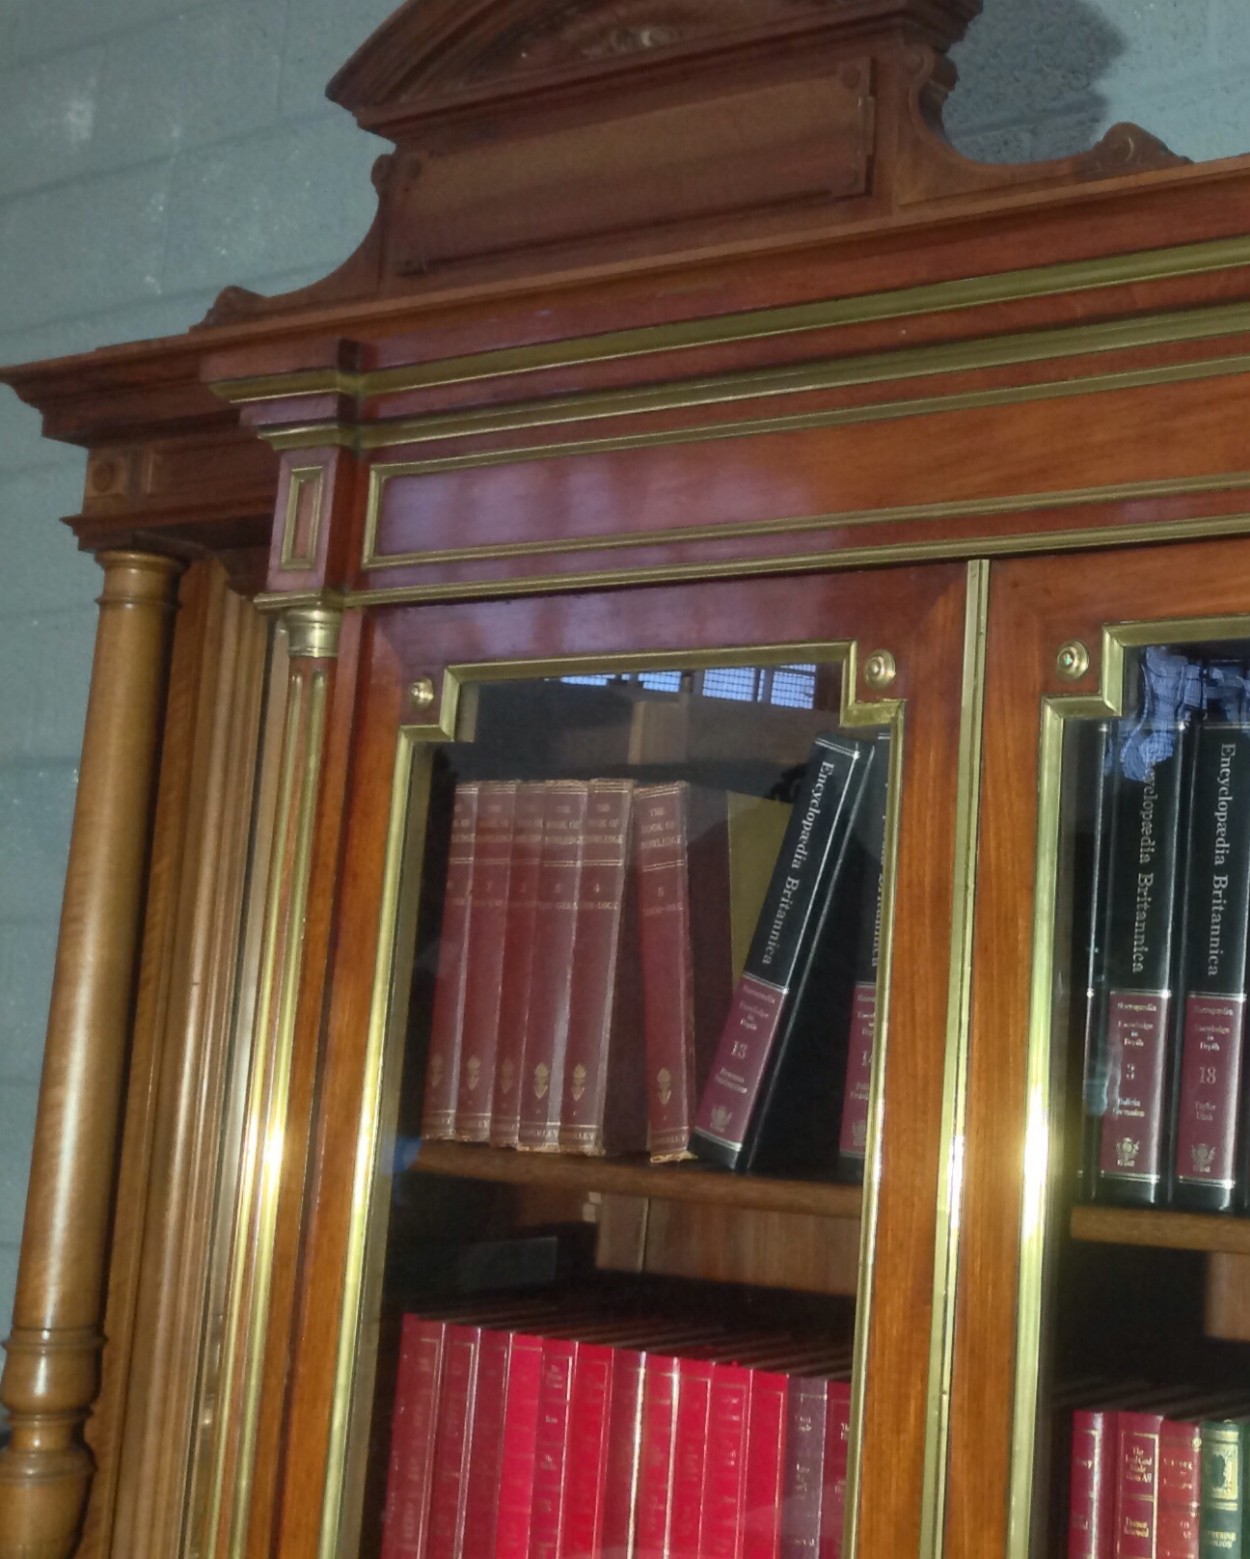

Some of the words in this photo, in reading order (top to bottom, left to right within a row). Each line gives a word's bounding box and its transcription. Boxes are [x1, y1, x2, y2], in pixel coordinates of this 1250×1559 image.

[791, 760, 834, 869] Encyclopædia
[1214, 743, 1236, 866] Encyclopædia
[761, 875, 800, 965] Britannica
[1132, 872, 1154, 974] Britannica
[1208, 874, 1229, 977] Britannica
[1199, 1065, 1217, 1085] 18
